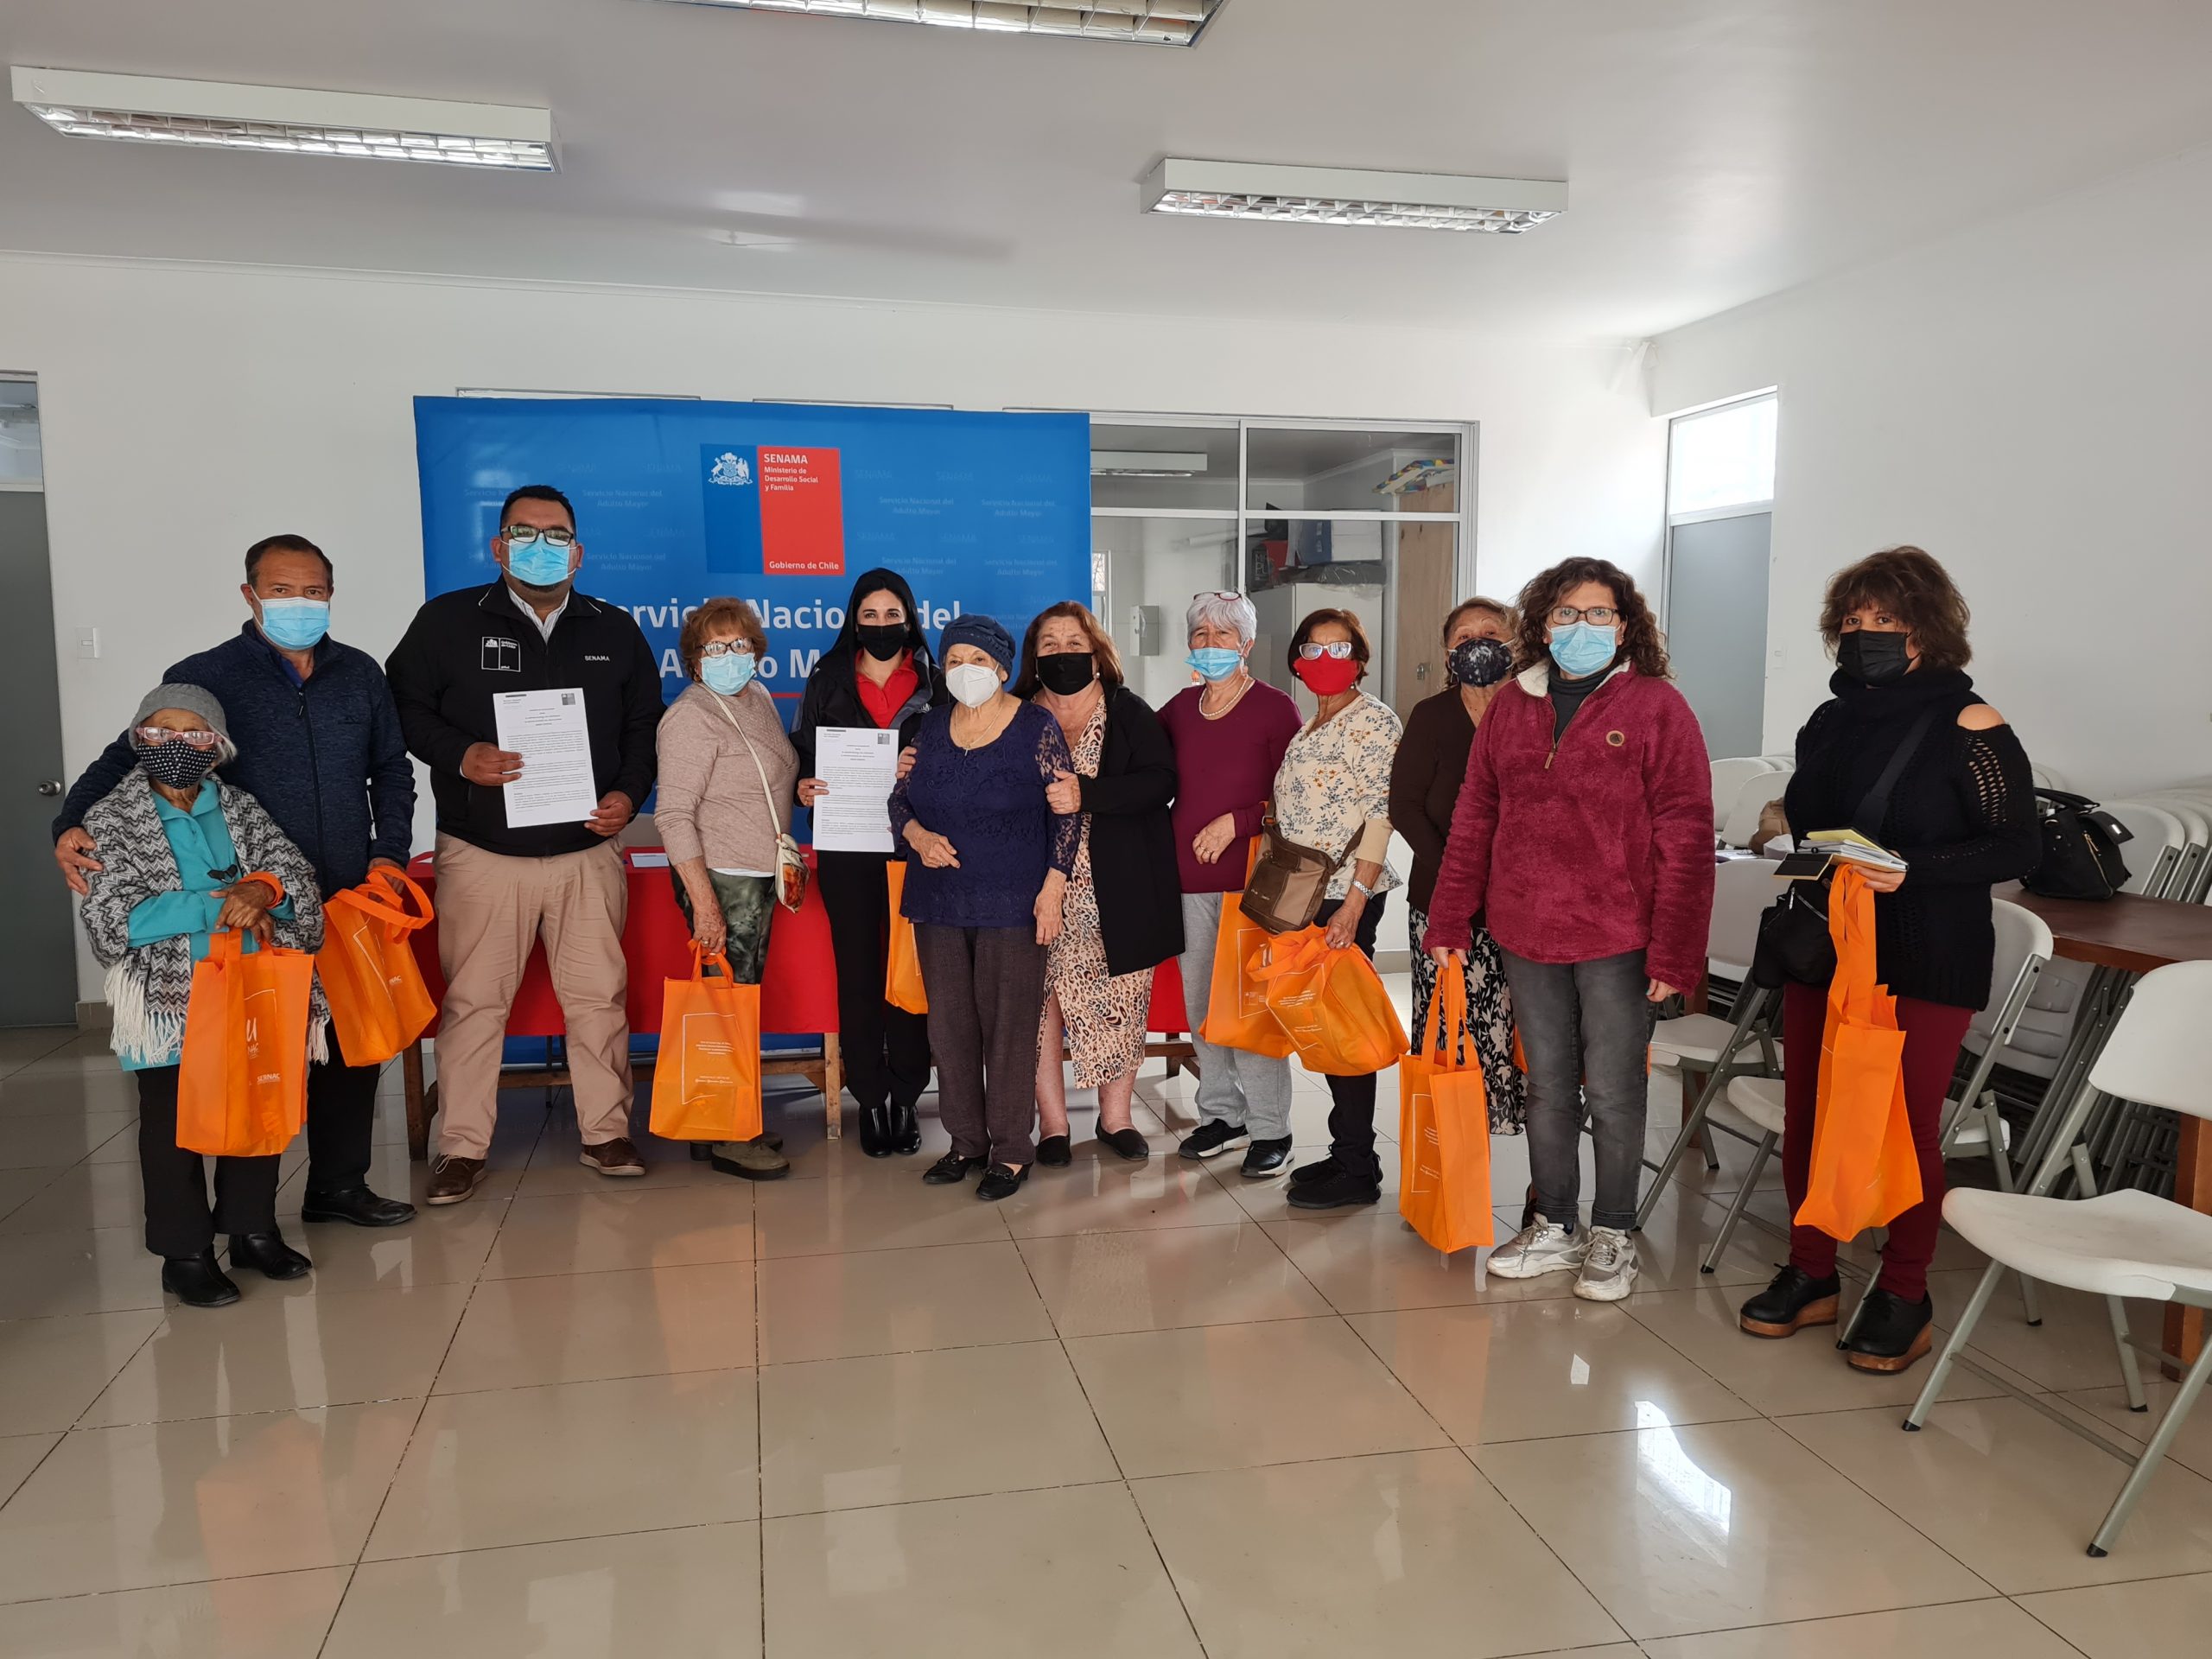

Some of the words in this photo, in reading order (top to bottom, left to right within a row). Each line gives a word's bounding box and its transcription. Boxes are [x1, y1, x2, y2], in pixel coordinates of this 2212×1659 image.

[764, 454, 808, 464] SENAMA
[769, 561, 805, 569] Gobierno
[818, 562, 839, 570] Chile
[746, 599, 844, 629] Nacio
